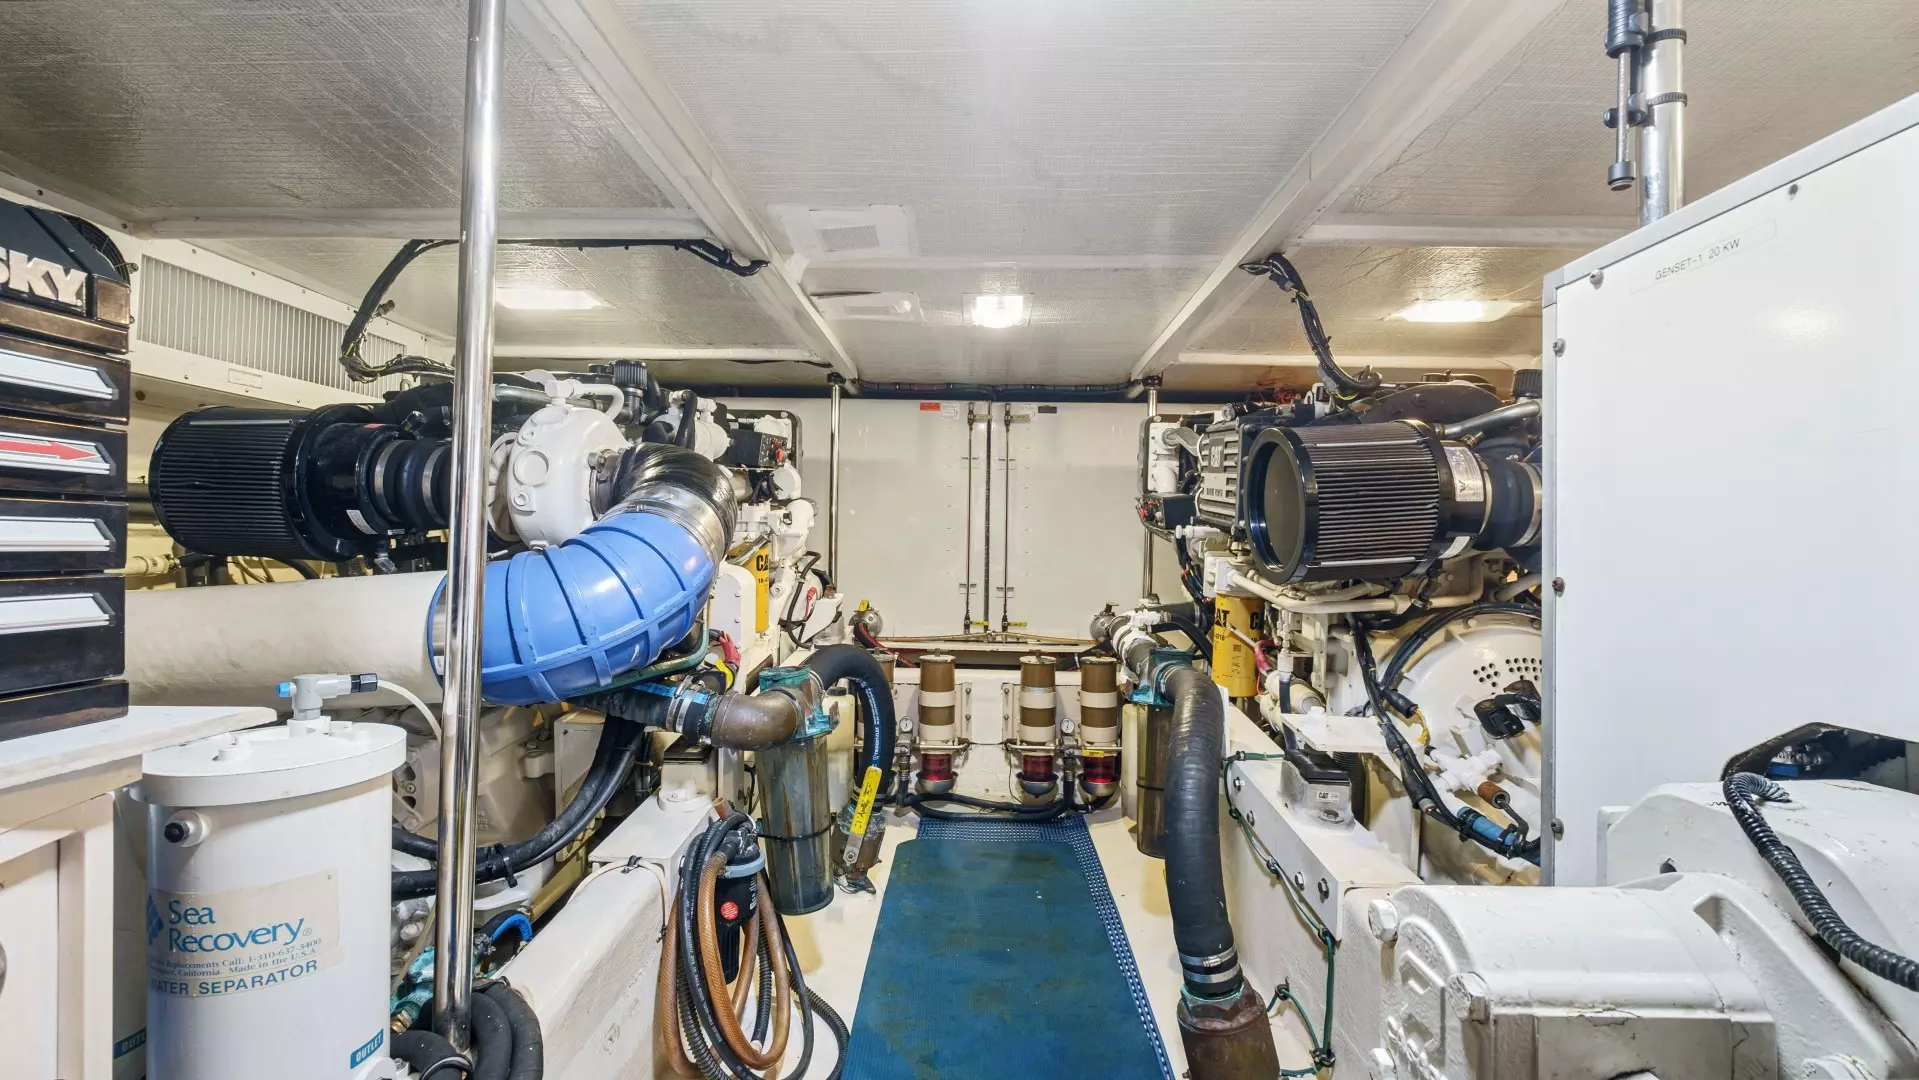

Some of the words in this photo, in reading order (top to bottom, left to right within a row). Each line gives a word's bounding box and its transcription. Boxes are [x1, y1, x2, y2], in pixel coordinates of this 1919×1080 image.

[1655, 254, 1702, 280] GENSET-1
[1708, 246, 1720, 259] 20
[1722, 238, 1740, 252] KW
[756, 554, 769, 572] CA
[1214, 607, 1230, 628] AT
[168, 900, 216, 925] Sea
[168, 918, 304, 953] Recovery
[222, 957, 245, 967] Call:
[228, 963, 255, 974] Made
[272, 956, 288, 965] the
[198, 959, 318, 995] SEPARATOR
[122, 1031, 146, 1052] OUTL
[355, 1033, 382, 1062] OUTLET
